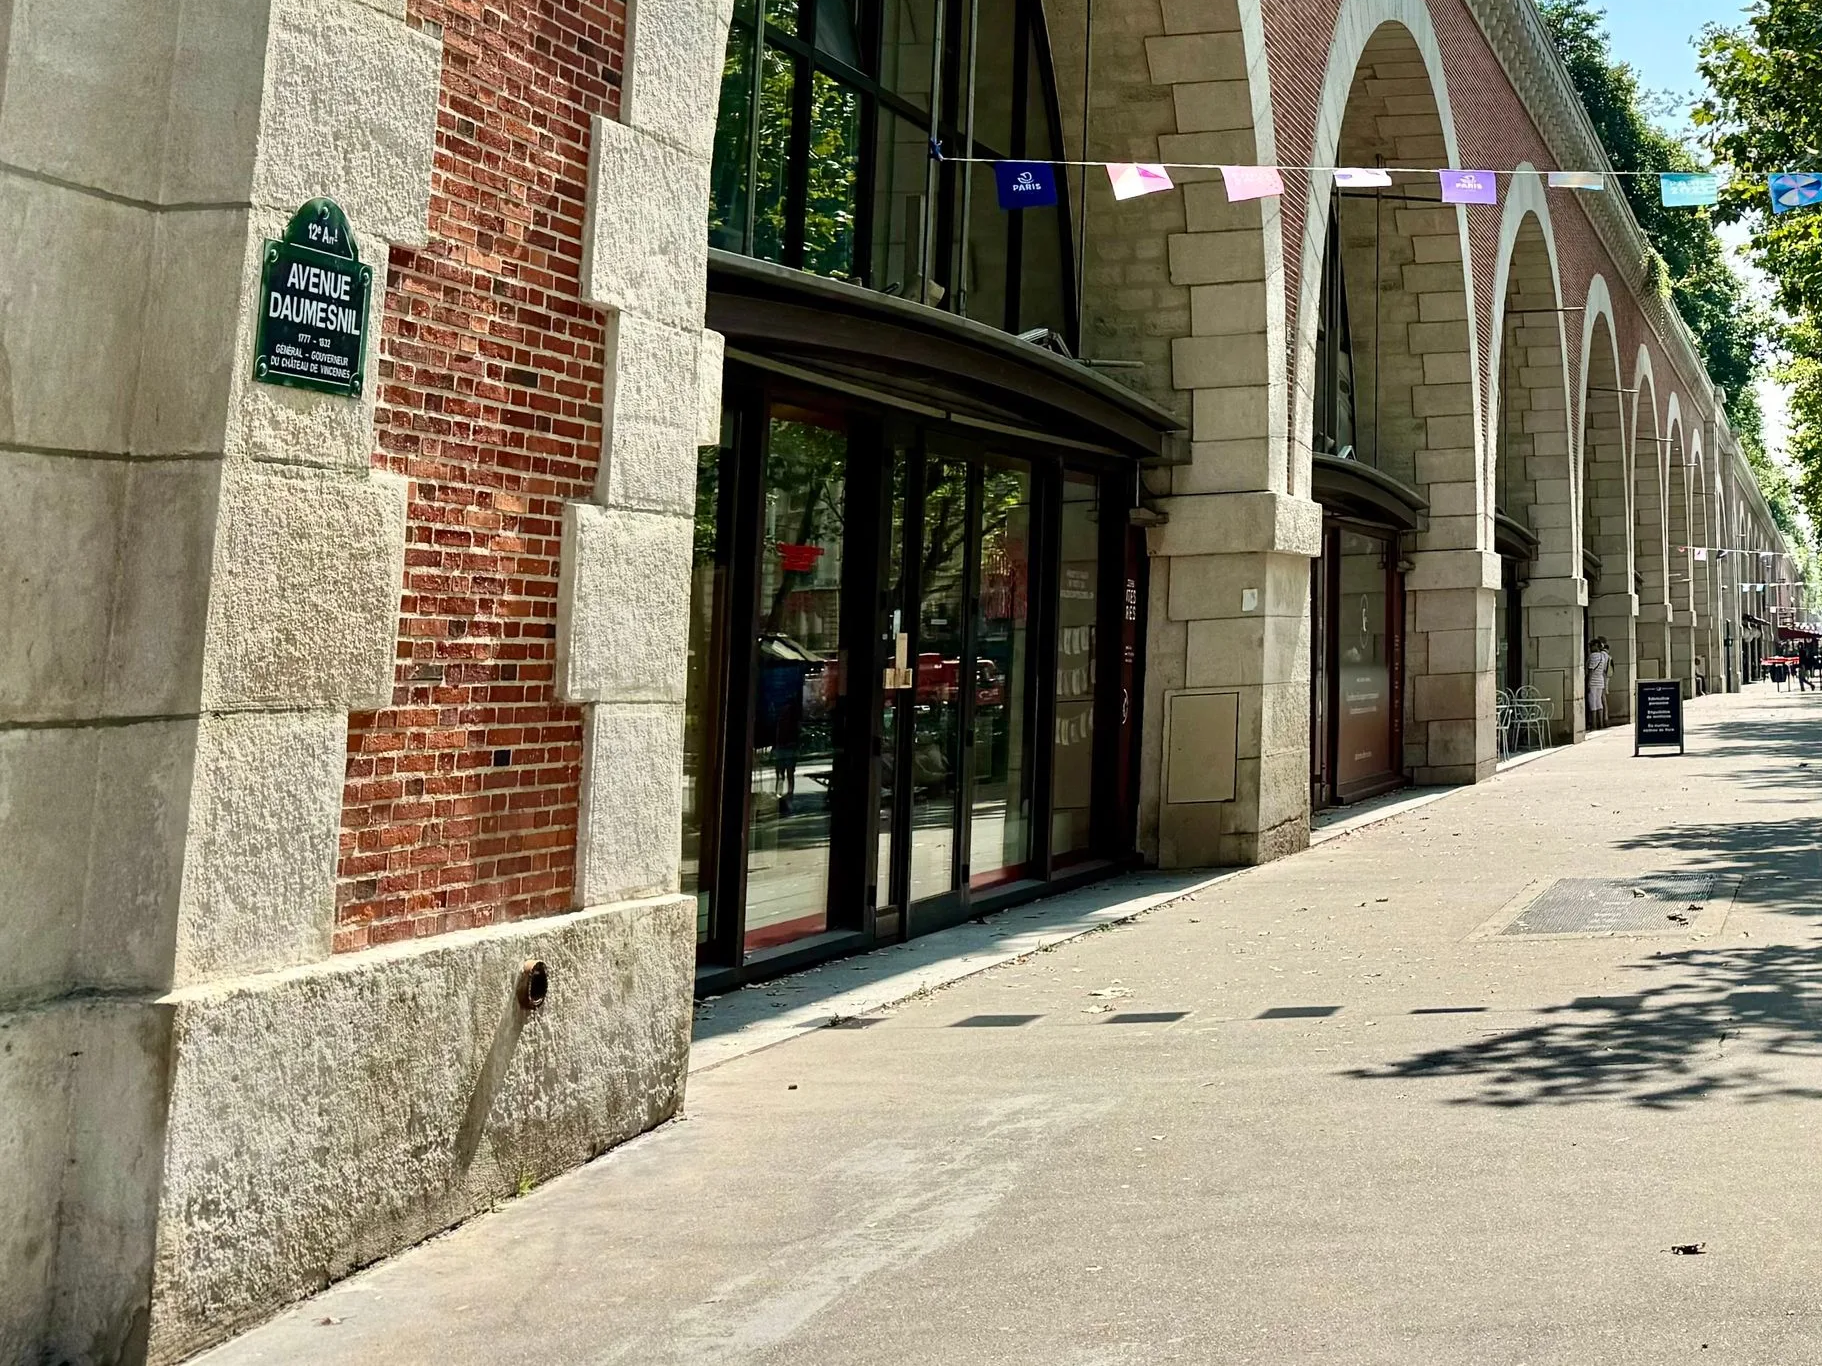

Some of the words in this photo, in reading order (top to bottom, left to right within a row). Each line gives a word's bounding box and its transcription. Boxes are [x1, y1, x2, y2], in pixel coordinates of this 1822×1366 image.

[1012, 183, 1042, 192] PARIS
[286, 262, 352, 301] AVENUE
[269, 291, 360, 335] DAUMESNIL
[298, 333, 311, 344] 1777
[270, 355, 280, 366] DU
[310, 362, 319, 373] DE
[320, 365, 351, 379] VINCENNES
[311, 350, 349, 366] GOUVERNEUR
